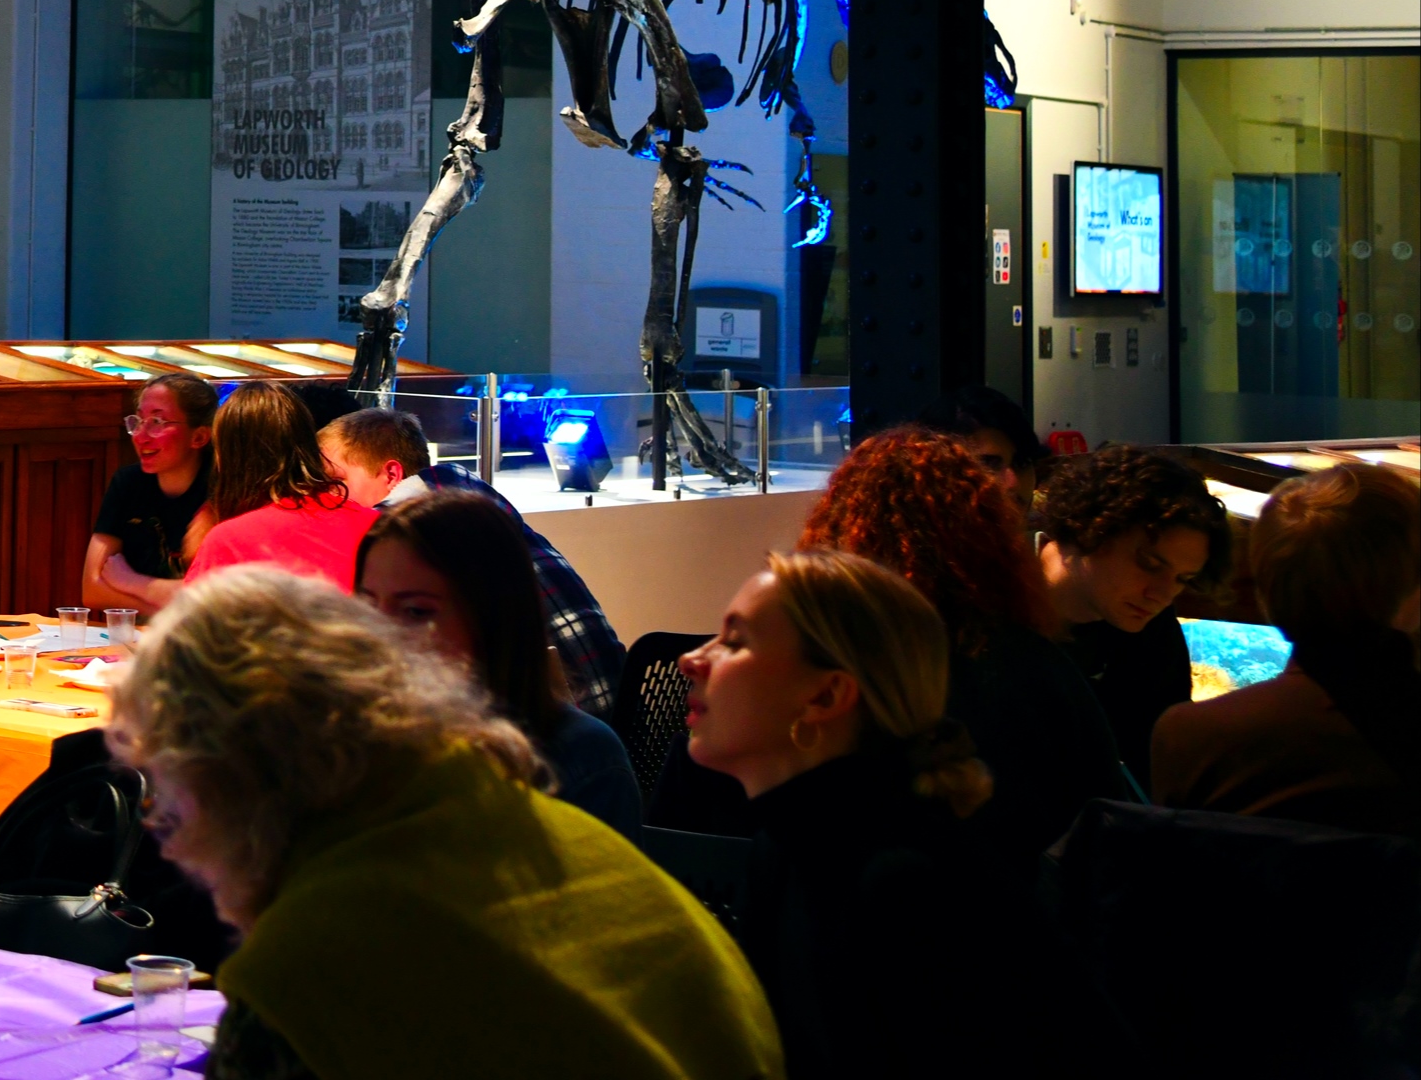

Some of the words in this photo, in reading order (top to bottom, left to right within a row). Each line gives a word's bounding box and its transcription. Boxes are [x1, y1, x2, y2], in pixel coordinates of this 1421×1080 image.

[233, 109, 326, 130] LAPWORTH
[233, 134, 309, 155] MUSEUM
[233, 158, 255, 180] OF
[260, 158, 342, 180] GEOLOGY
